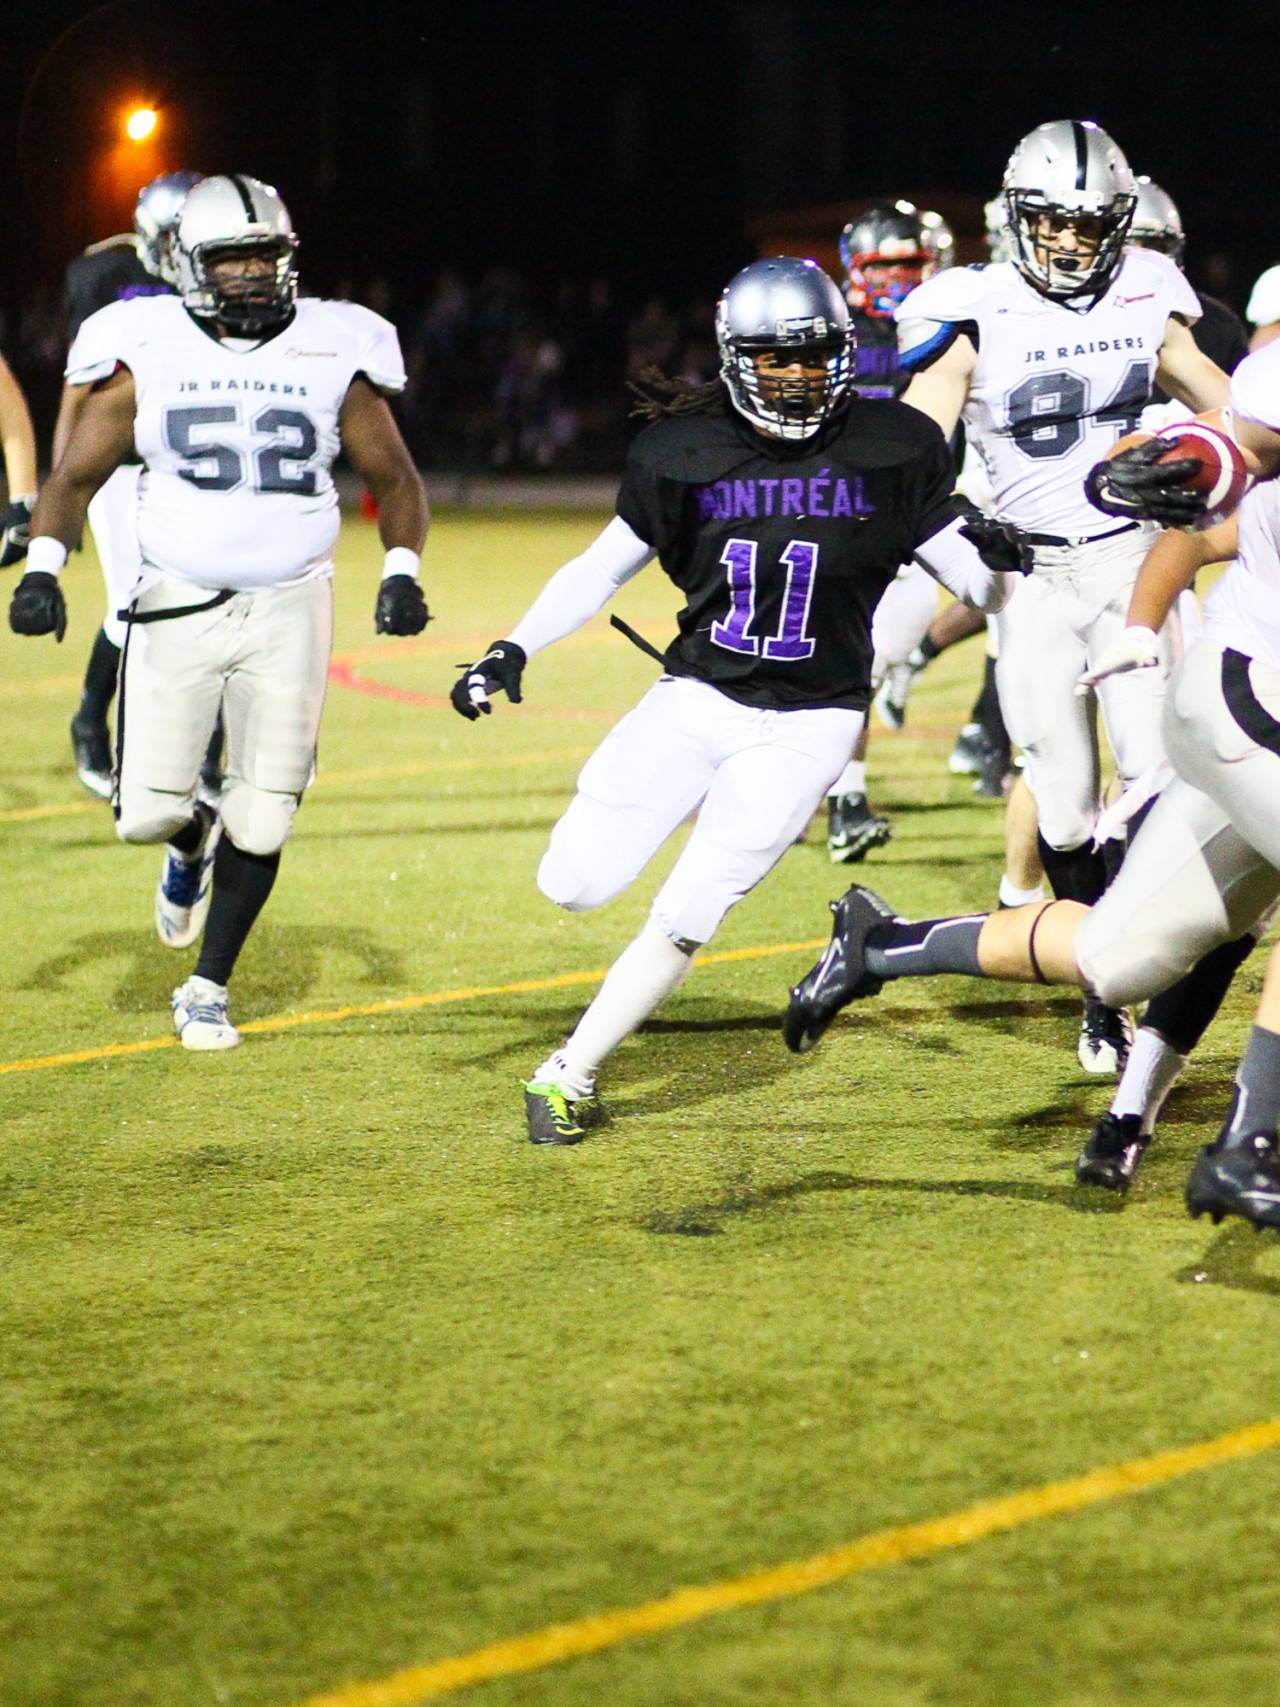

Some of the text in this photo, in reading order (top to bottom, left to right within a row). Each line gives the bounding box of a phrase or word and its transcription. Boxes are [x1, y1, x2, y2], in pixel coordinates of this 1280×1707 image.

[179, 379, 308, 396] JR RAIDERS
[1025, 337, 1144, 363] JR RAIDERS
[161, 401, 318, 495] 52
[1003, 357, 1153, 463] 84
[710, 538, 819, 661] 11
